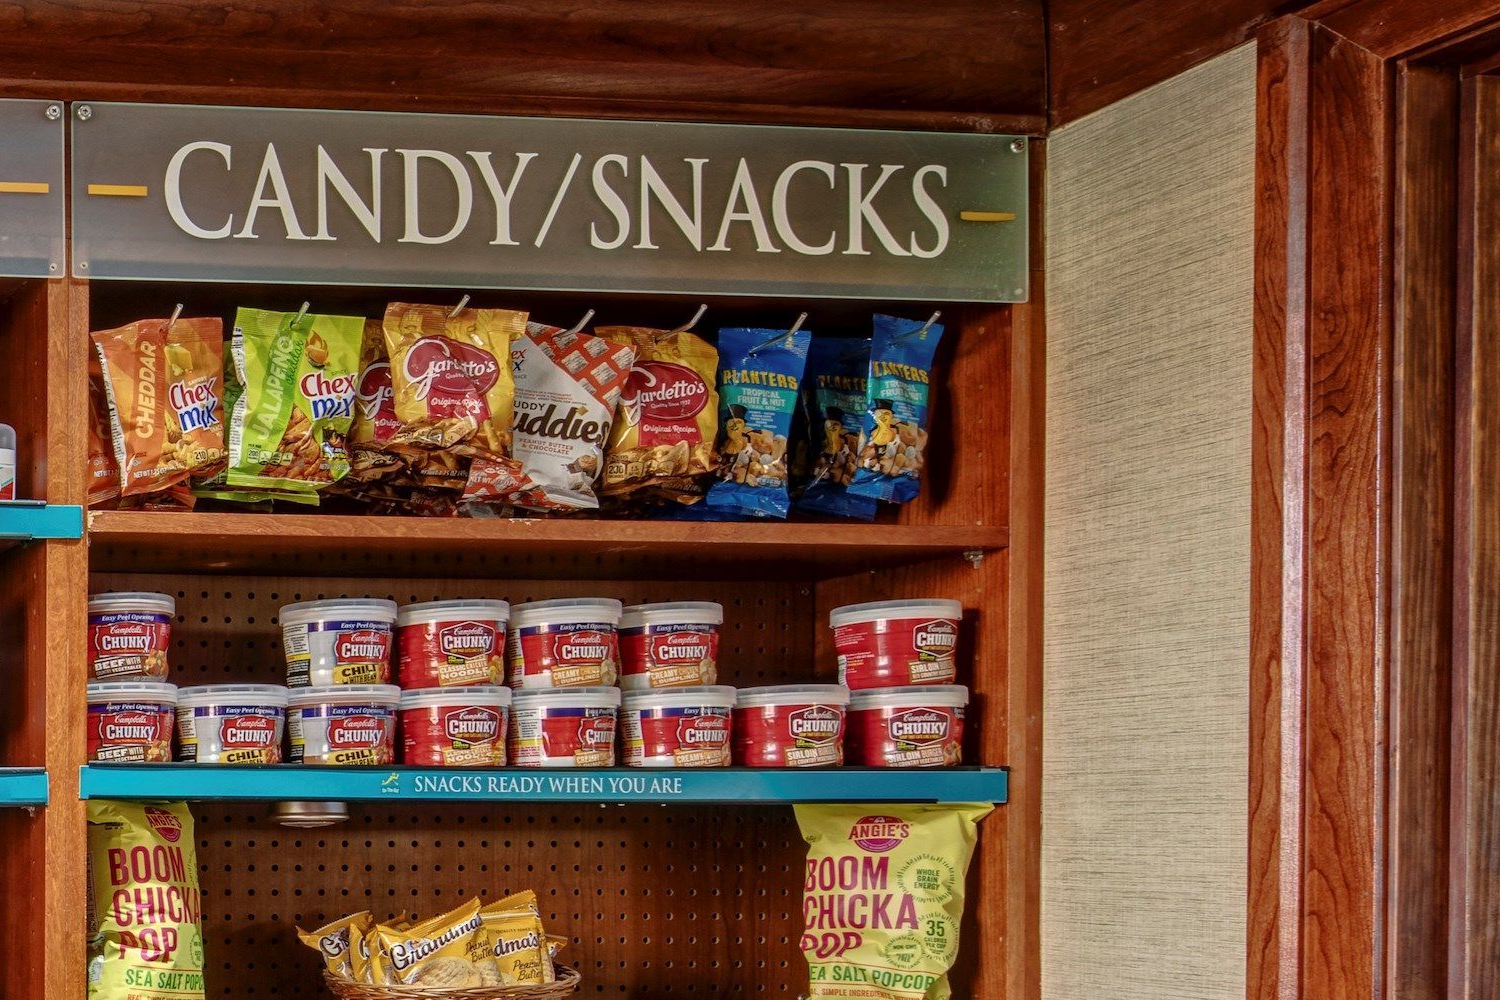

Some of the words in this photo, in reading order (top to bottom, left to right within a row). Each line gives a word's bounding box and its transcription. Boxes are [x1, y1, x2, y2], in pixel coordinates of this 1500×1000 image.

[164, 141, 950, 258] CANDY/SNACKS
[300, 373, 358, 397] Chex
[723, 370, 798, 390] PLANTERS
[136, 341, 156, 439] CHEDDAR
[169, 378, 217, 410] Chex
[742, 388, 780, 398] TROPICAL
[312, 395, 355, 420] mix
[738, 396, 759, 404] FRUIT
[770, 398, 785, 407] NUT
[179, 398, 219, 431] mix
[513, 404, 610, 449] uddies
[643, 425, 670, 434] Original
[672, 425, 697, 435] Recipe
[117, 614, 129, 622] Peel
[131, 614, 154, 622] Opening
[110, 625, 142, 635] Campbell's
[102, 634, 151, 650] CHUNKY
[444, 634, 492, 650] CHUNKY
[916, 632, 957, 647] CHUNKY
[341, 643, 385, 658] CHUNKY
[562, 644, 608, 660] CHUNKY
[658, 644, 707, 661] CHUNKY
[94, 658, 124, 671] BEEF
[125, 656, 141, 666] WITH
[342, 665, 376, 677] CHILI
[440, 668, 488, 679] NOODLE
[114, 714, 147, 724] Campbell's
[449, 719, 496, 734] CHUNKY
[793, 719, 839, 733] CHUNKY
[106, 724, 155, 740] CHUNKY
[227, 729, 274, 744] CHUNKY
[335, 729, 383, 744] CHUNKY
[685, 728, 728, 742] CHUNKY
[893, 721, 946, 736] CHUNKY
[98, 748, 127, 760] BEEF
[128, 747, 143, 756] WITH
[227, 750, 262, 762] CHILI
[335, 750, 372, 762] CHILI
[414, 776, 482, 793] SNACKS
[487, 777, 544, 793] READY
[548, 777, 604, 793] WHEN
[608, 777, 645, 793] YOU
[650, 777, 682, 793] ARE
[149, 813, 182, 829] ANGIE'S
[849, 822, 911, 840] ANGIE'S
[108, 845, 186, 886] BOOM
[916, 868, 940, 876] WHOLE
[806, 856, 890, 892] BOOM
[914, 882, 940, 891] ENERGY
[112, 886, 200, 927] CHICKA
[803, 893, 919, 930] CHICKA
[926, 920, 945, 937] 35
[118, 927, 177, 963] POP
[800, 931, 863, 959] POP
[126, 968, 153, 987] SEA
[158, 972, 182, 990] SALT
[185, 973, 205, 991] POPC
[810, 966, 826, 980] EA
[833, 966, 868, 983] SALT
[872, 970, 933, 991] POPCOR
